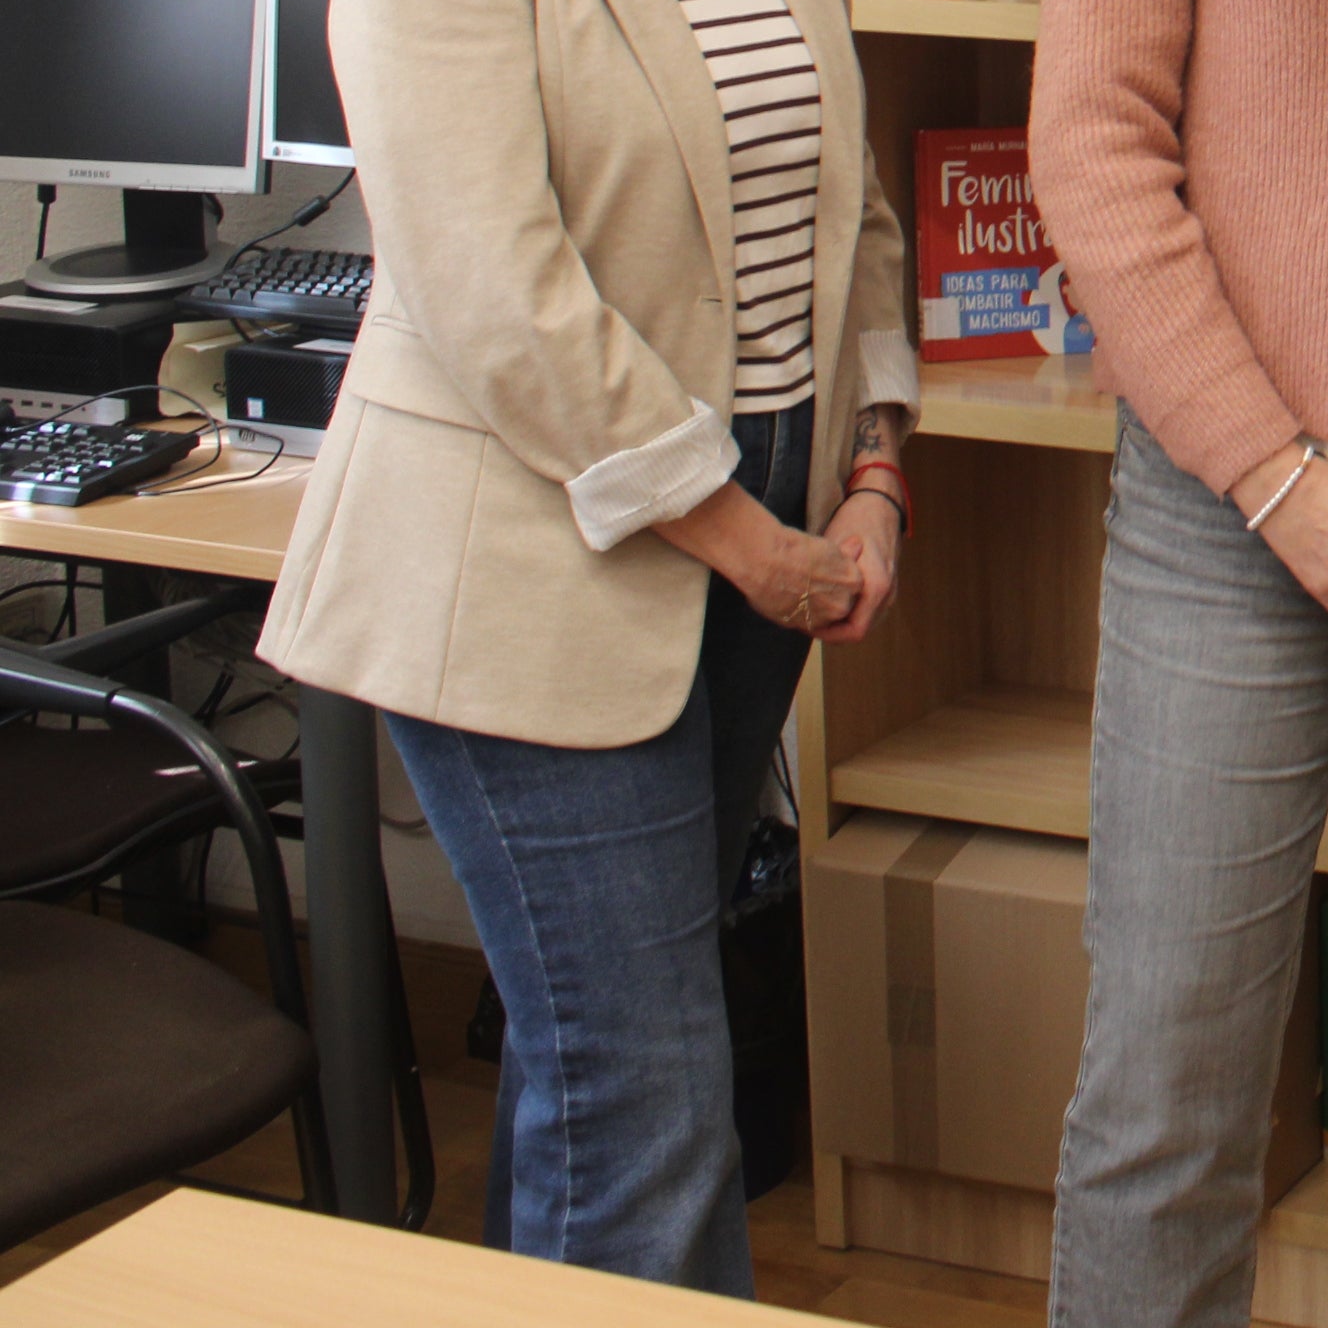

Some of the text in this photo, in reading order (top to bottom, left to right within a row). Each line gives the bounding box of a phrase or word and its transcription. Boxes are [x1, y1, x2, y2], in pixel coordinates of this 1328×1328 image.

[68, 169, 111, 179] SAMSUNG
[946, 273, 1029, 293] IDEAS PARA
[958, 292, 1014, 311] OMBATIR
[969, 310, 1041, 330] MACHISMO
